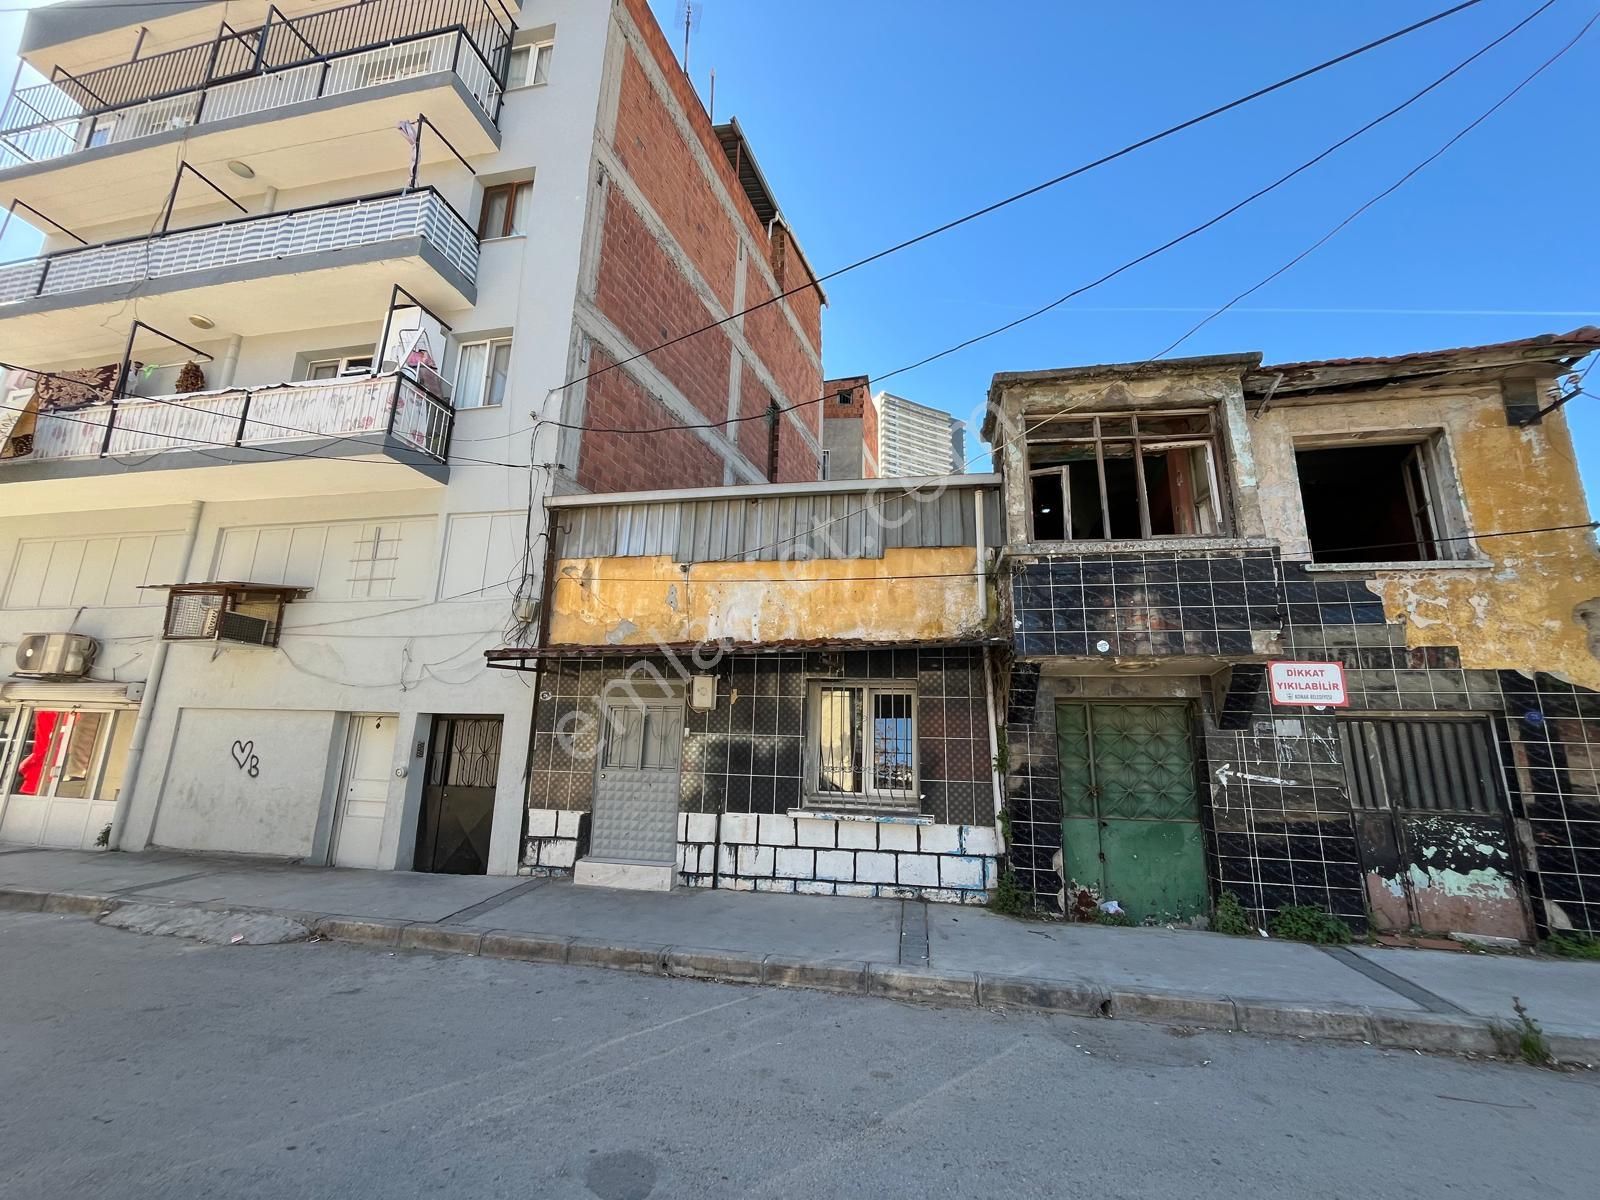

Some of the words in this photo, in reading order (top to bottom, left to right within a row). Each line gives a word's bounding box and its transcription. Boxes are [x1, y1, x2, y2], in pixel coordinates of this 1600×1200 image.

[1286, 668, 1325, 677] DİKKAT
[1277, 681, 1340, 691] YIKILABİLİR
[248, 754, 259, 778] B
